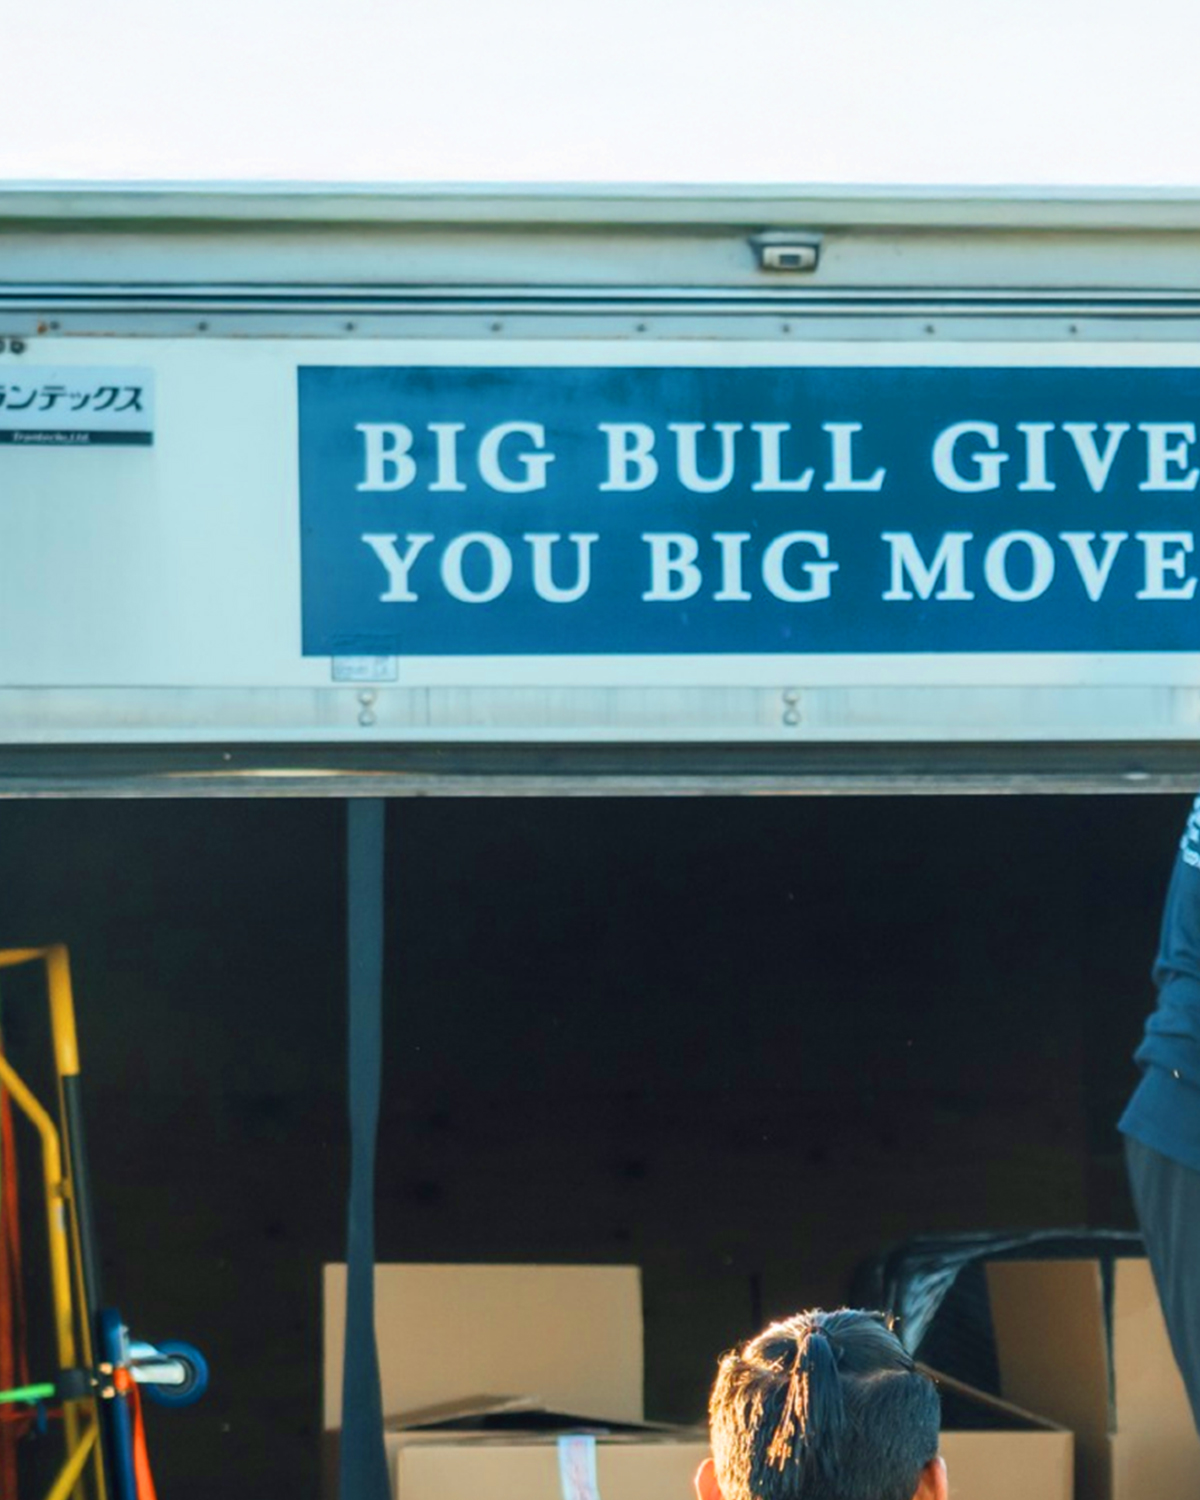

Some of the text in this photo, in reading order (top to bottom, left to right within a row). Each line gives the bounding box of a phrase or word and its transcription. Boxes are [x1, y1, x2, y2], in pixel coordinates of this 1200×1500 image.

[0, 384, 143, 412] ンテックス
[355, 421, 1200, 493] BIG BULL GIVE
[361, 531, 1197, 604] YOU BIG MOVE
